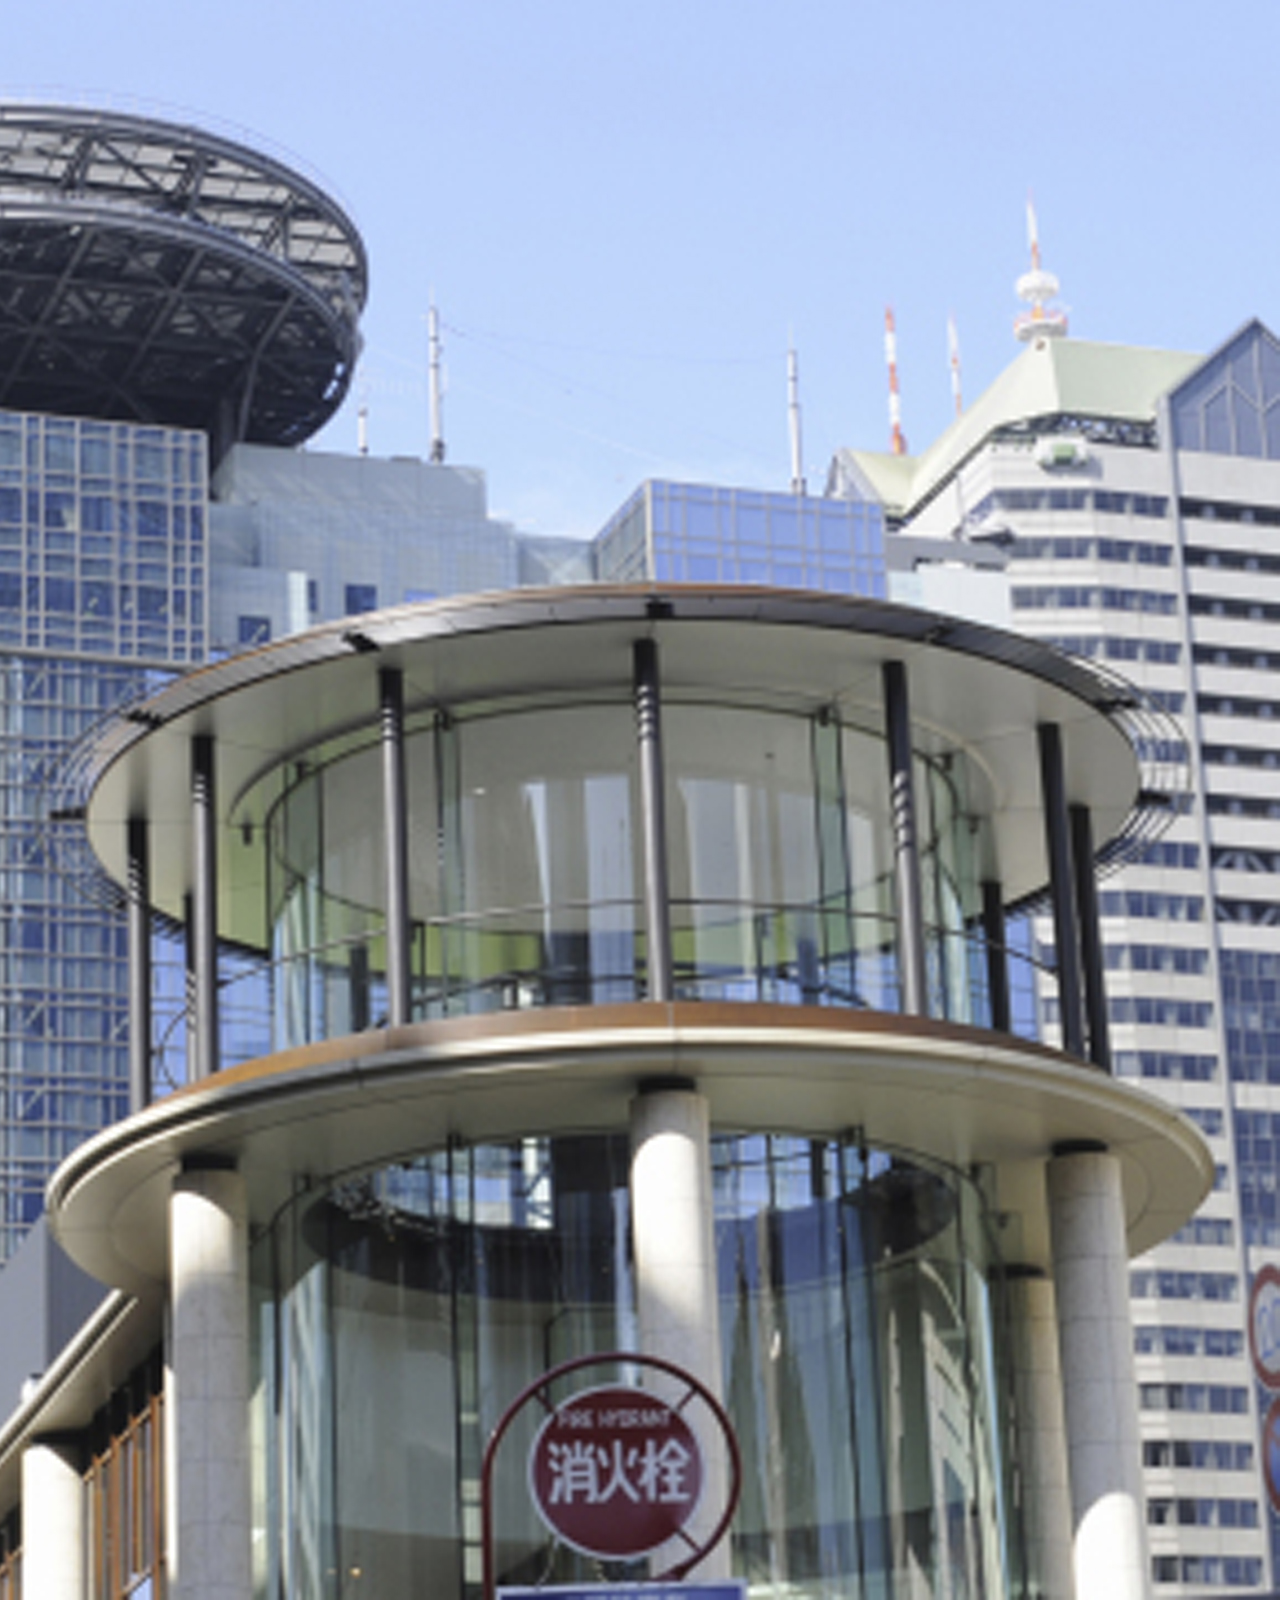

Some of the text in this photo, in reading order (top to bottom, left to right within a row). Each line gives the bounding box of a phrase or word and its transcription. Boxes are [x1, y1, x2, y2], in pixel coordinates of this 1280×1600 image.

[558, 1408, 594, 1429] FIRE
[547, 1438, 691, 1504] 消火栓
